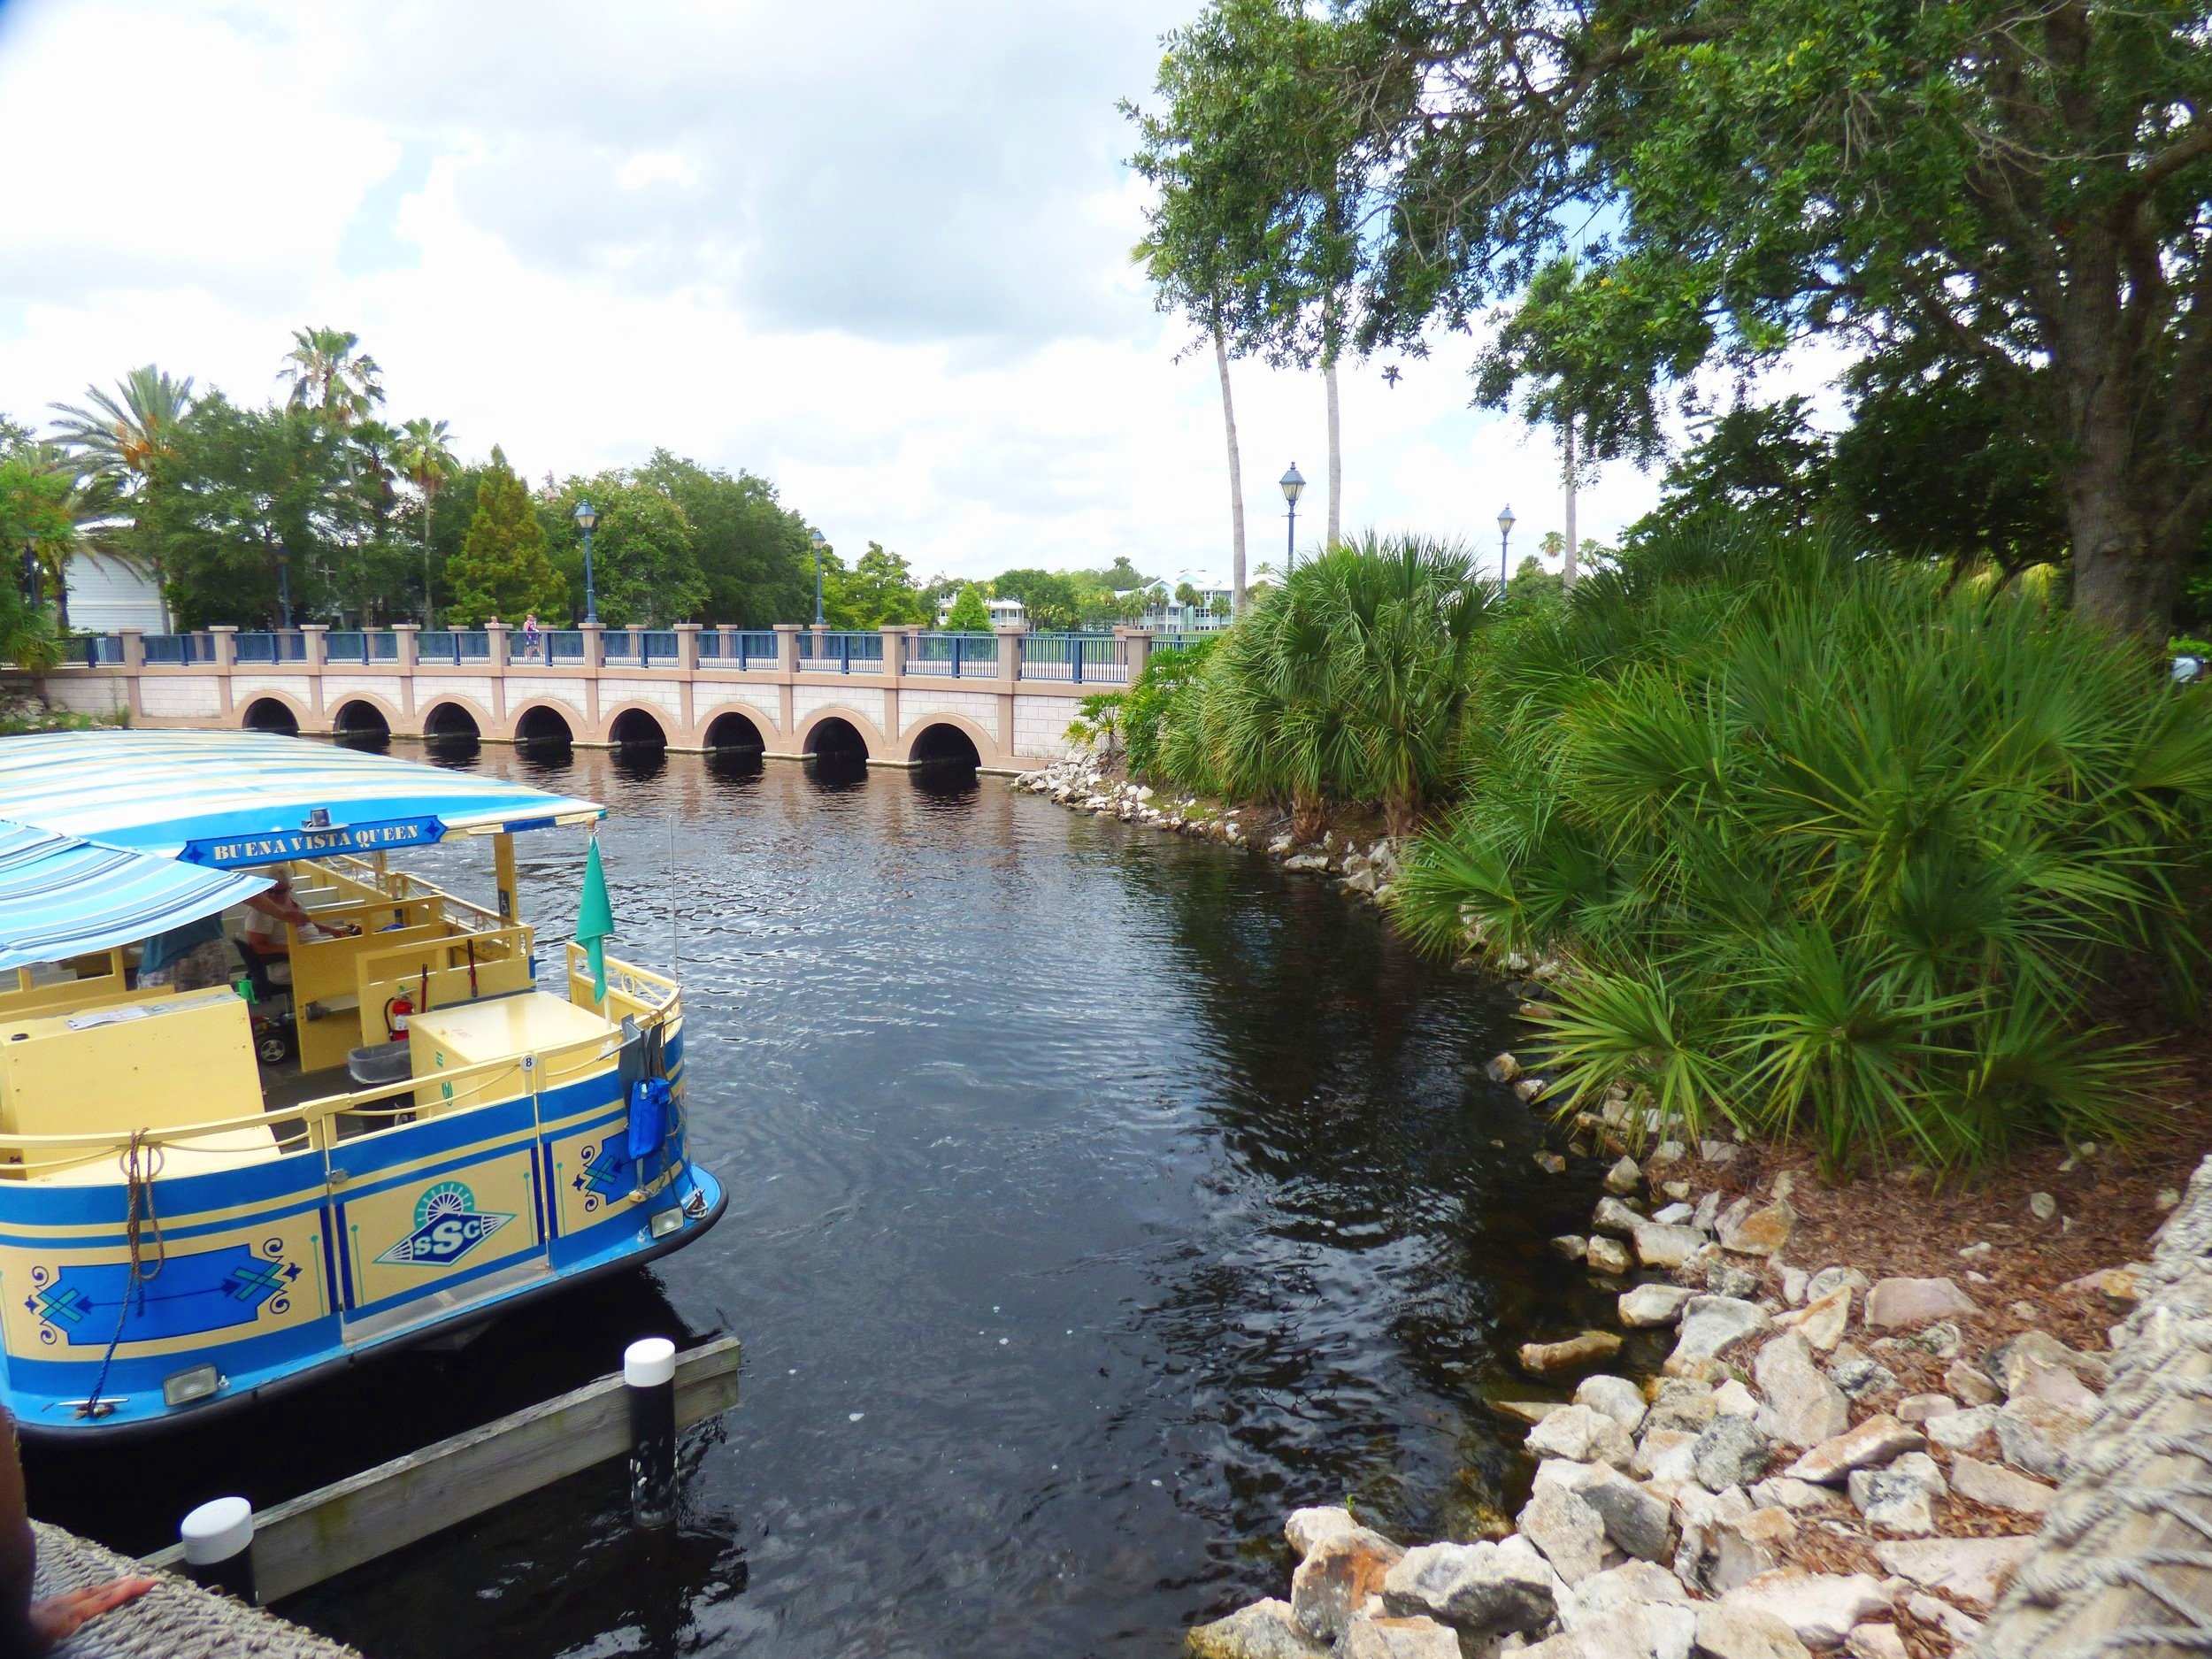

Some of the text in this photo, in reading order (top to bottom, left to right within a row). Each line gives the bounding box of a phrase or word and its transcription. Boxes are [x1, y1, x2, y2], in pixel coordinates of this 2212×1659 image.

[214, 824, 419, 860] BUENA VISTA QUEEN
[526, 1057, 533, 1067] 8
